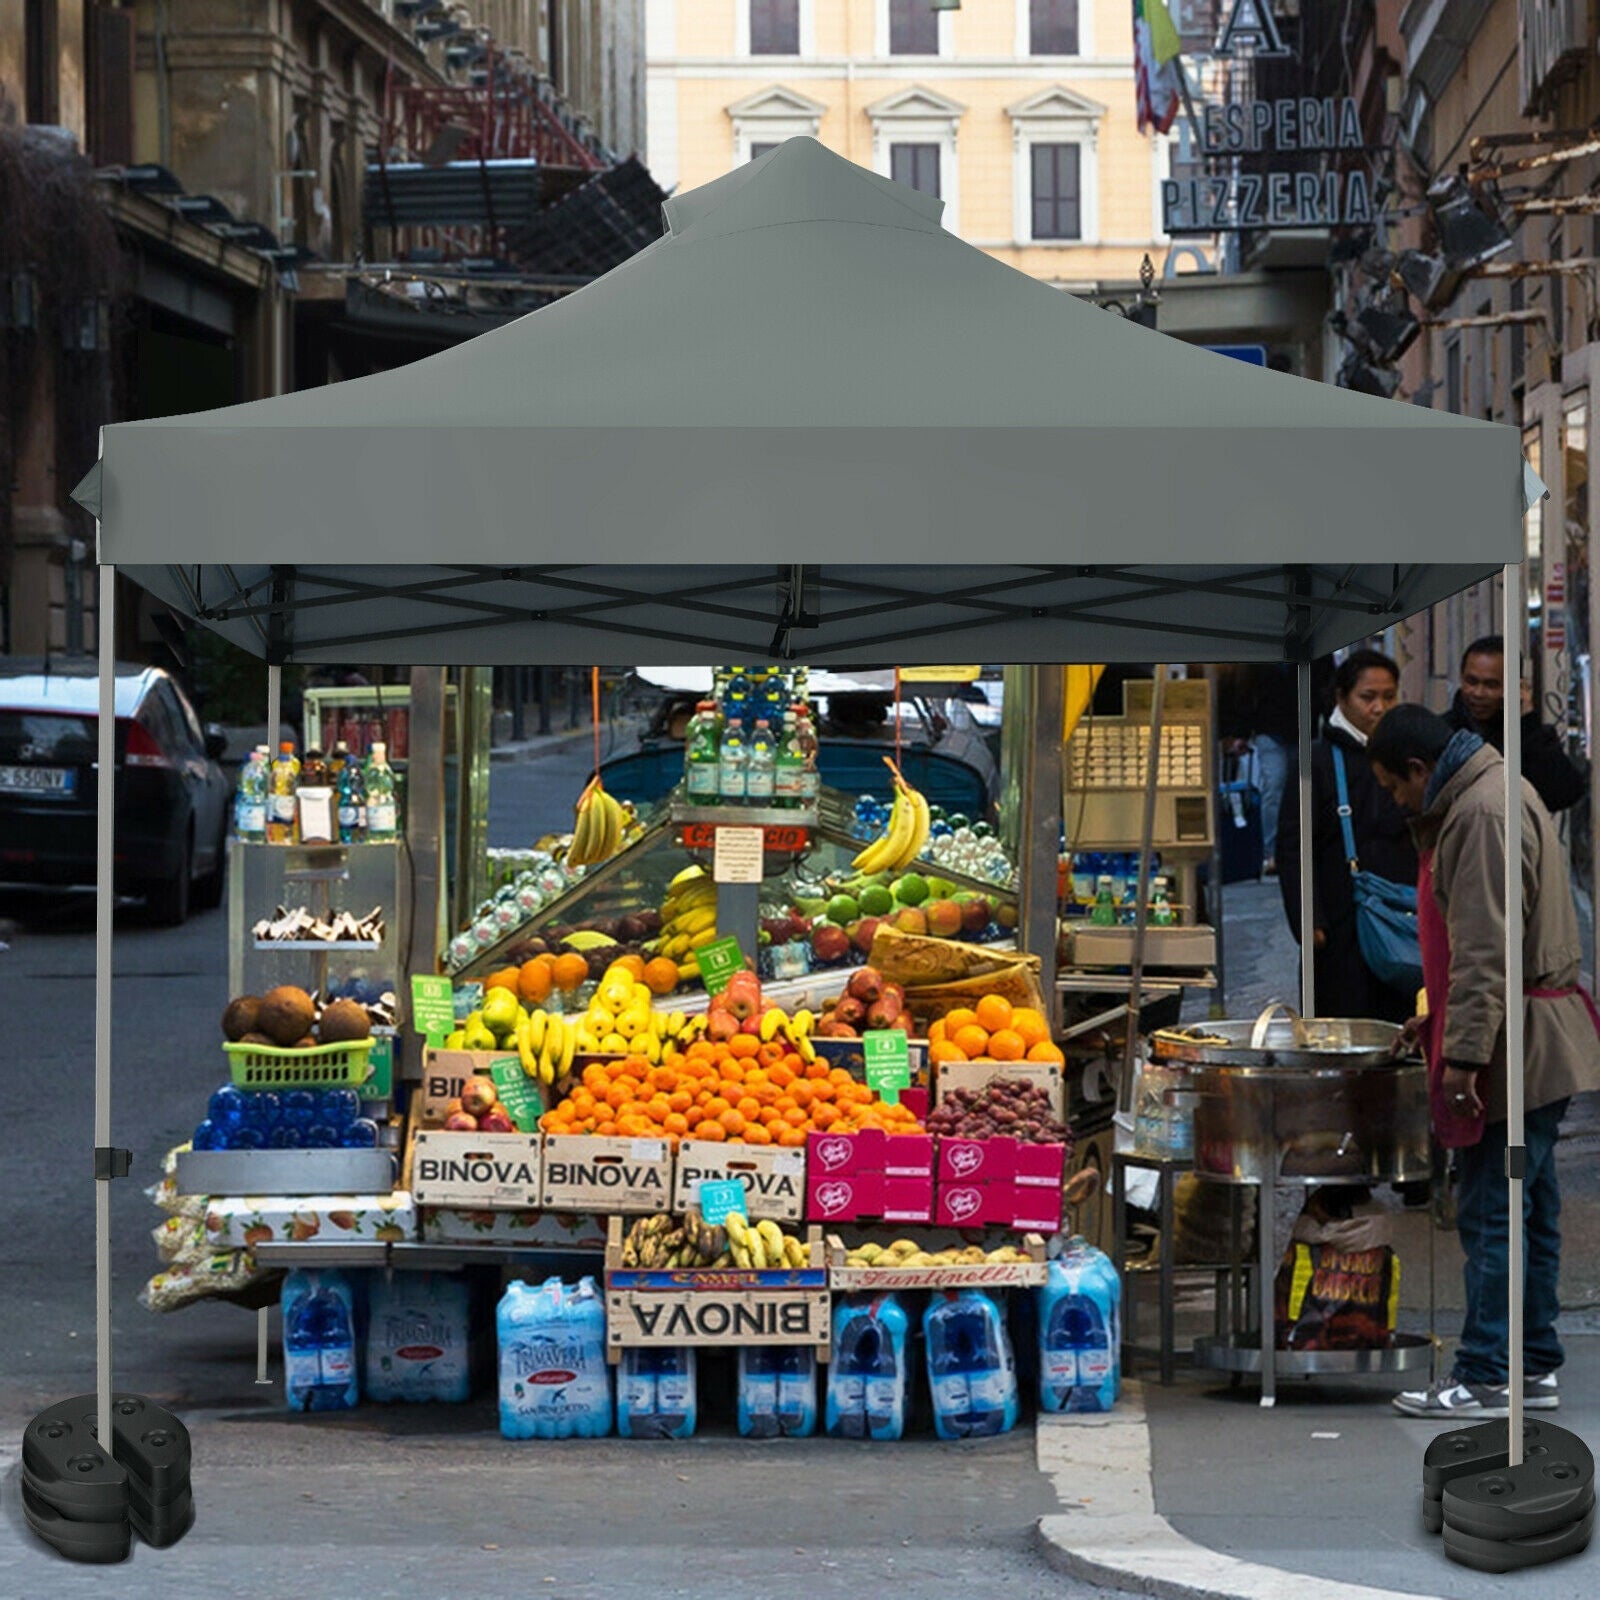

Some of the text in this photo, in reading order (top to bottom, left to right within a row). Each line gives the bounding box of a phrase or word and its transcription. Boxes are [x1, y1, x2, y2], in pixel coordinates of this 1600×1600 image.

[1203, 96, 1364, 152] ESPERIA
[1161, 170, 1374, 228] PIZZERIA
[420, 1159, 535, 1184] BINOVA
[548, 1163, 662, 1188] BINOVA
[629, 1301, 812, 1337] BINOVA
